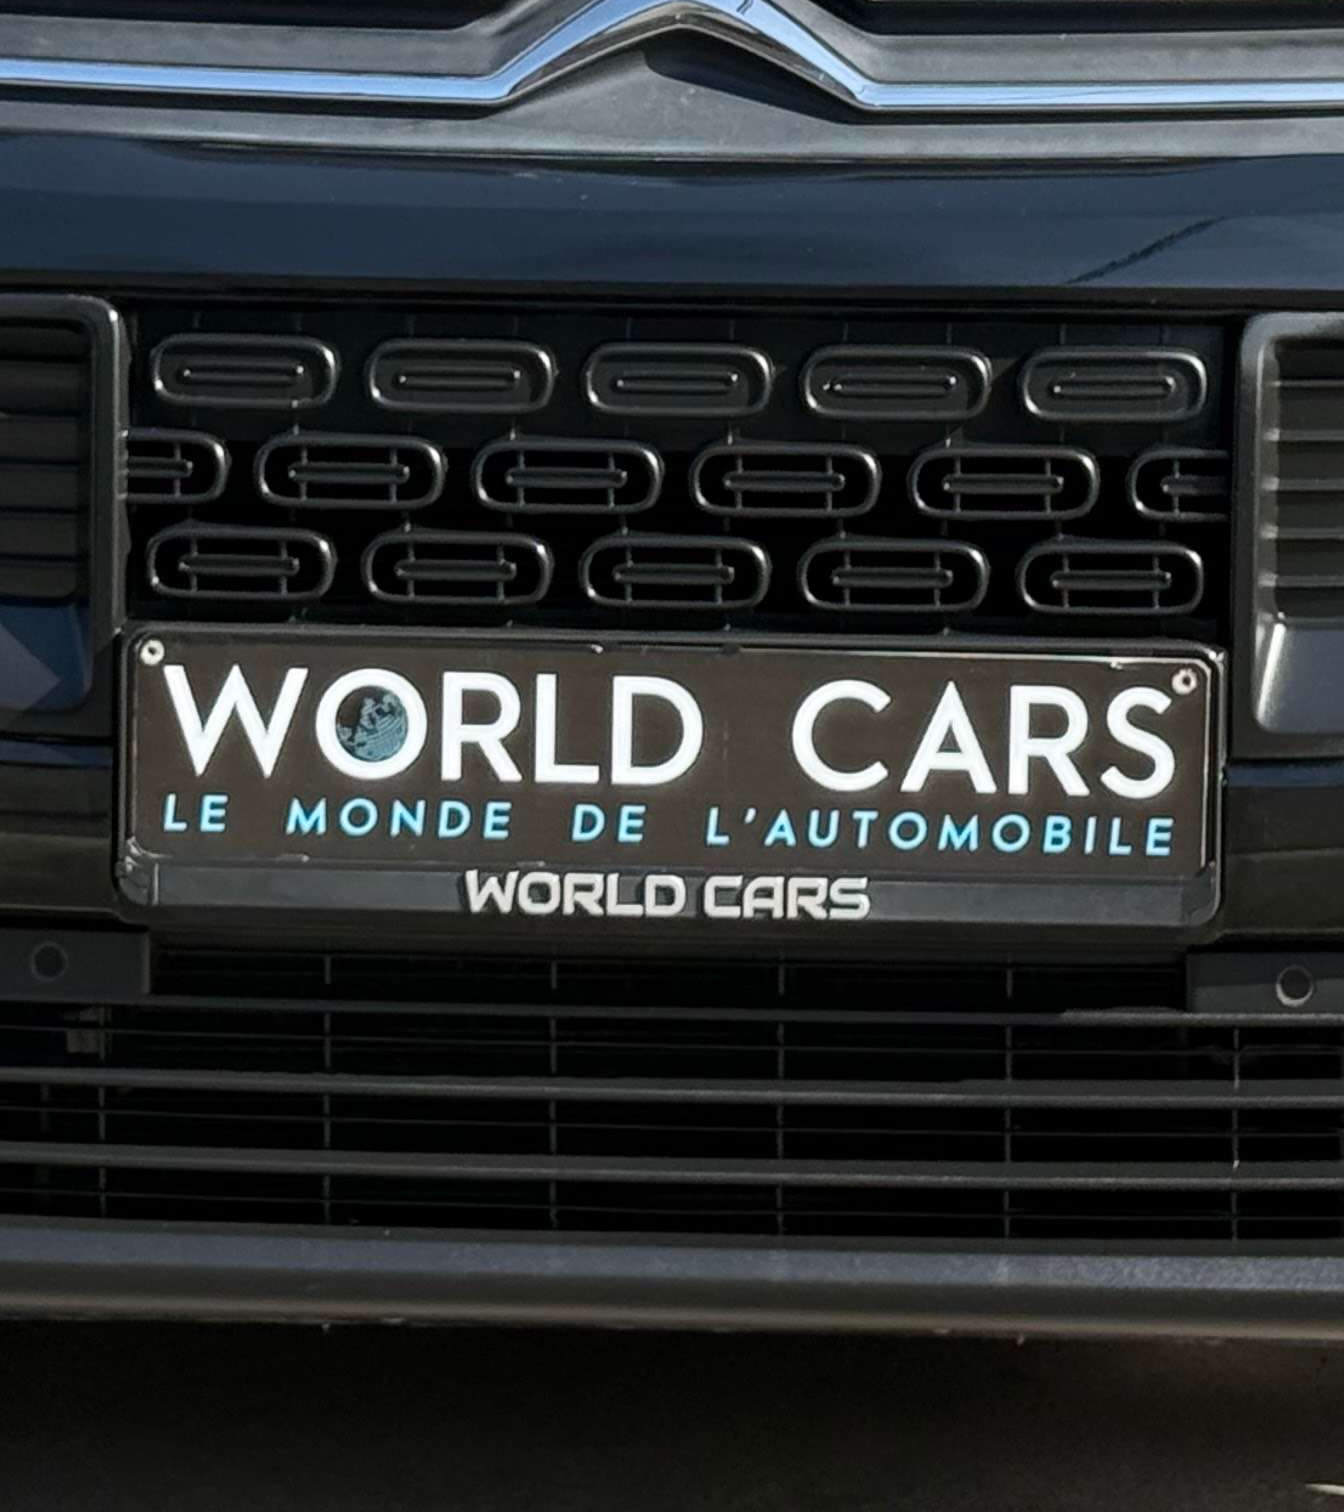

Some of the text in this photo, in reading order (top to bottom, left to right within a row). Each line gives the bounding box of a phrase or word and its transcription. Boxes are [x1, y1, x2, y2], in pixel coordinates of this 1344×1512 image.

[162, 663, 1176, 799] WORLD CARS
[163, 793, 1175, 857] LE MONDE DE L'AUTOMOBILE
[464, 869, 872, 921] WORLD CARS
